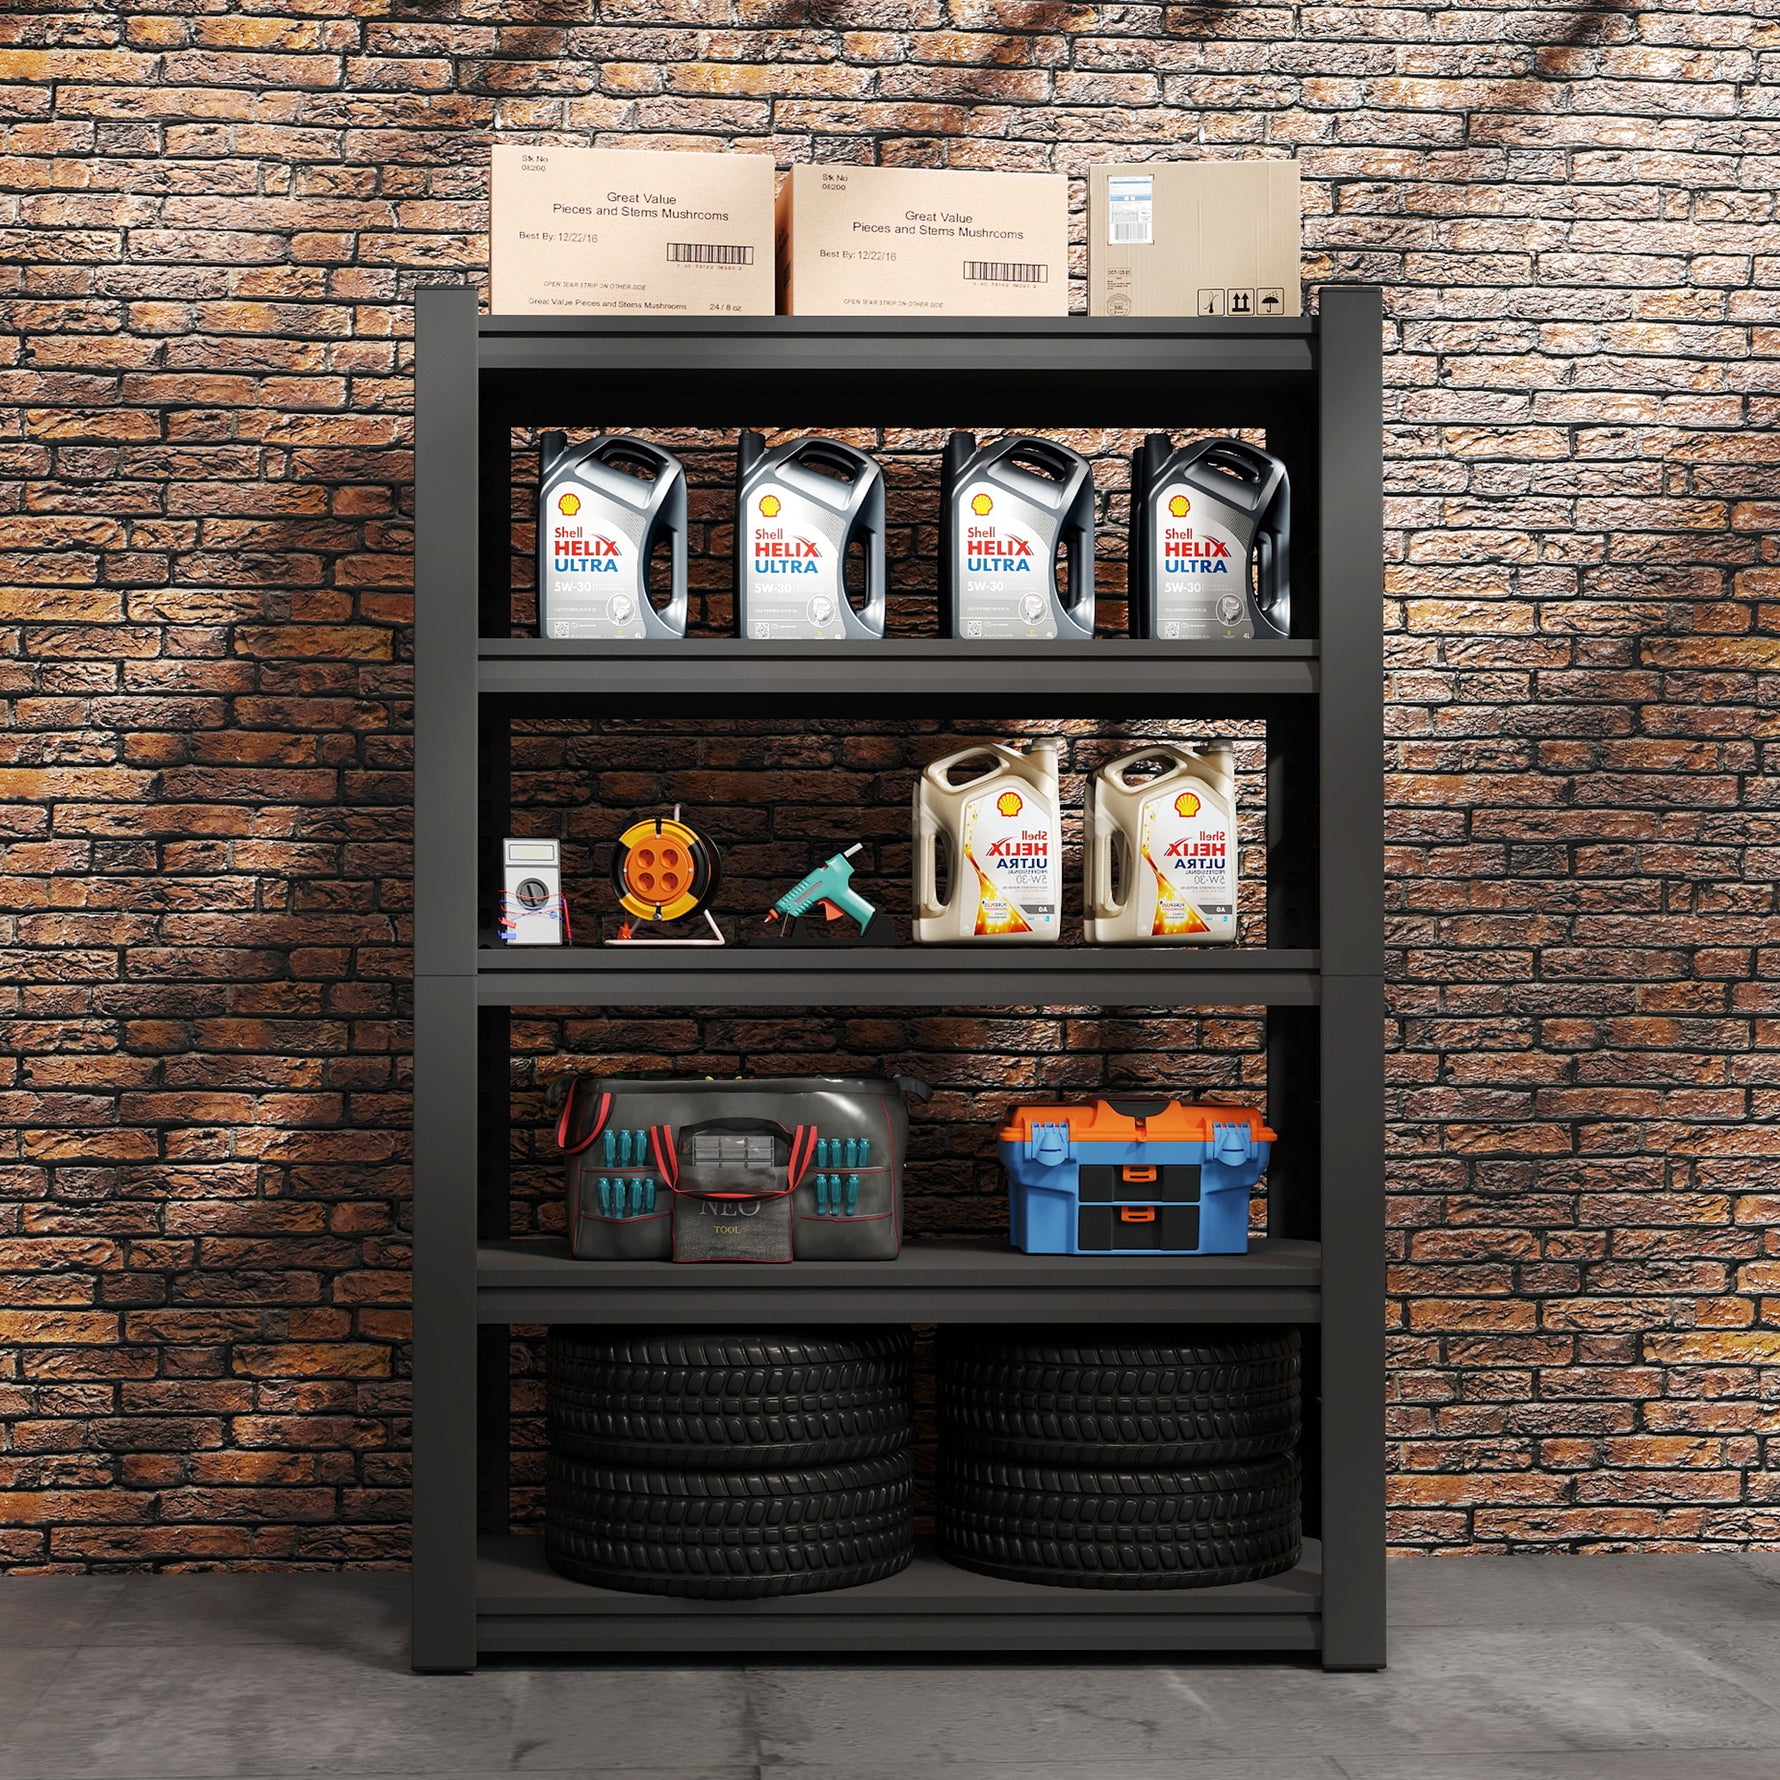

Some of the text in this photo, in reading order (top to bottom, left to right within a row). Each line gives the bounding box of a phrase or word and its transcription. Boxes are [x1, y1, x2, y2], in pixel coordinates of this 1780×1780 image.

[536, 155, 548, 163] No
[836, 175, 848, 183] No
[607, 192, 676, 205] Great Value
[553, 204, 728, 221] Pieces and Stems Mushrooms
[906, 211, 973, 223] Great Value
[853, 222, 1023, 239] Pieces and Stems Mushrooms
[519, 232, 539, 241] Best
[559, 233, 598, 243] 12/22/16
[820, 249, 839, 258] Best
[859, 251, 896, 261] 12/22/16
[709, 303, 720, 311] 24
[554, 526, 583, 538] Shell
[755, 528, 783, 540] Shell
[967, 526, 995, 538] Shell
[1165, 528, 1192, 540] Shell
[554, 539, 620, 556] HELIX
[755, 540, 820, 558] HELIX
[967, 539, 1032, 556] HELIX
[1165, 540, 1229, 558] HELIX
[555, 559, 618, 572] ULTRA
[755, 560, 818, 574] ULTRA
[968, 558, 1030, 572] ULTRA
[1165, 560, 1228, 574] ULTRA
[554, 582, 591, 592] 5W-30
[754, 583, 792, 594] 5W-30
[967, 581, 1004, 592] 5W-30
[1164, 582, 1201, 593] 5W-30
[699, 1201, 761, 1217] NEO
[713, 1225, 741, 1235] TOOL
